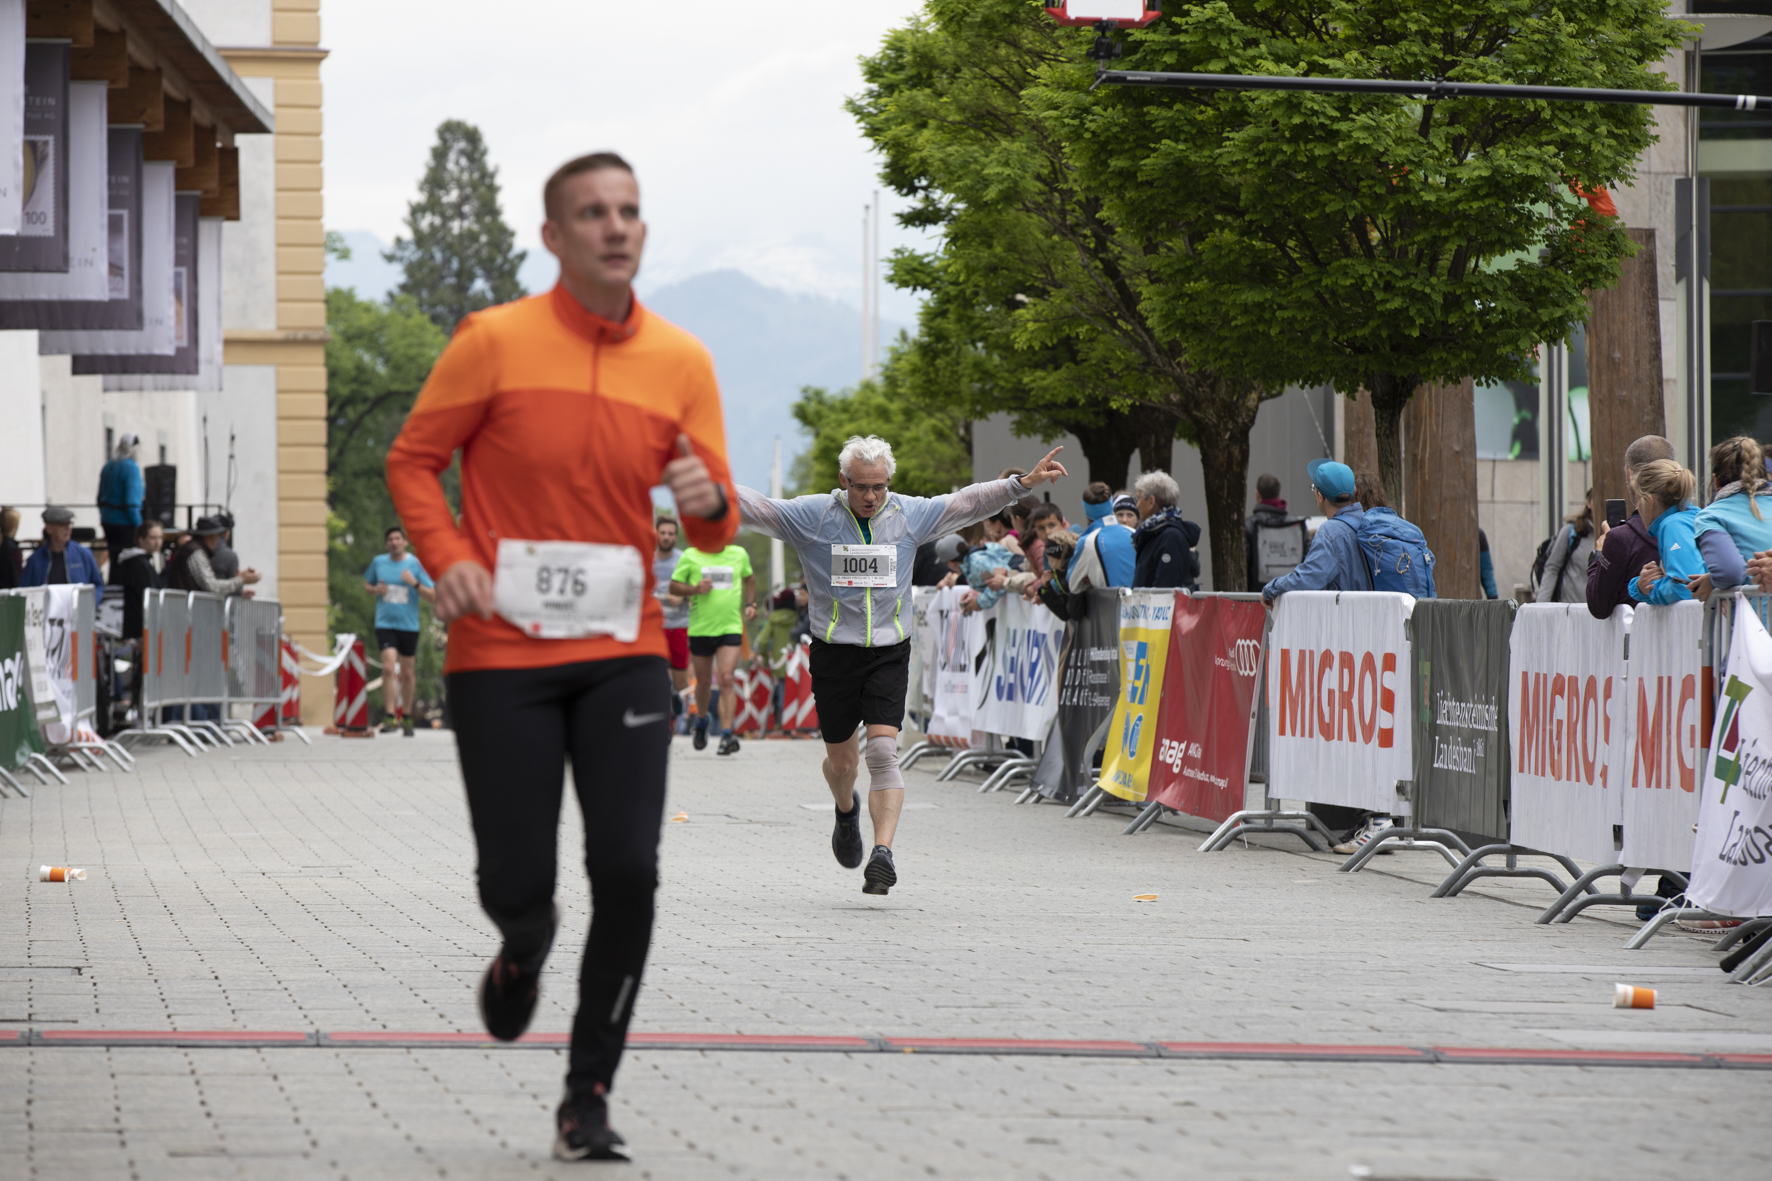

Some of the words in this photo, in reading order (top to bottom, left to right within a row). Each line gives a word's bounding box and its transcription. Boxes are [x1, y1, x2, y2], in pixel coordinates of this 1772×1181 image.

[843, 557, 878, 573] 1004
[535, 566, 588, 597] 876
[1278, 648, 1397, 748] MIGROS
